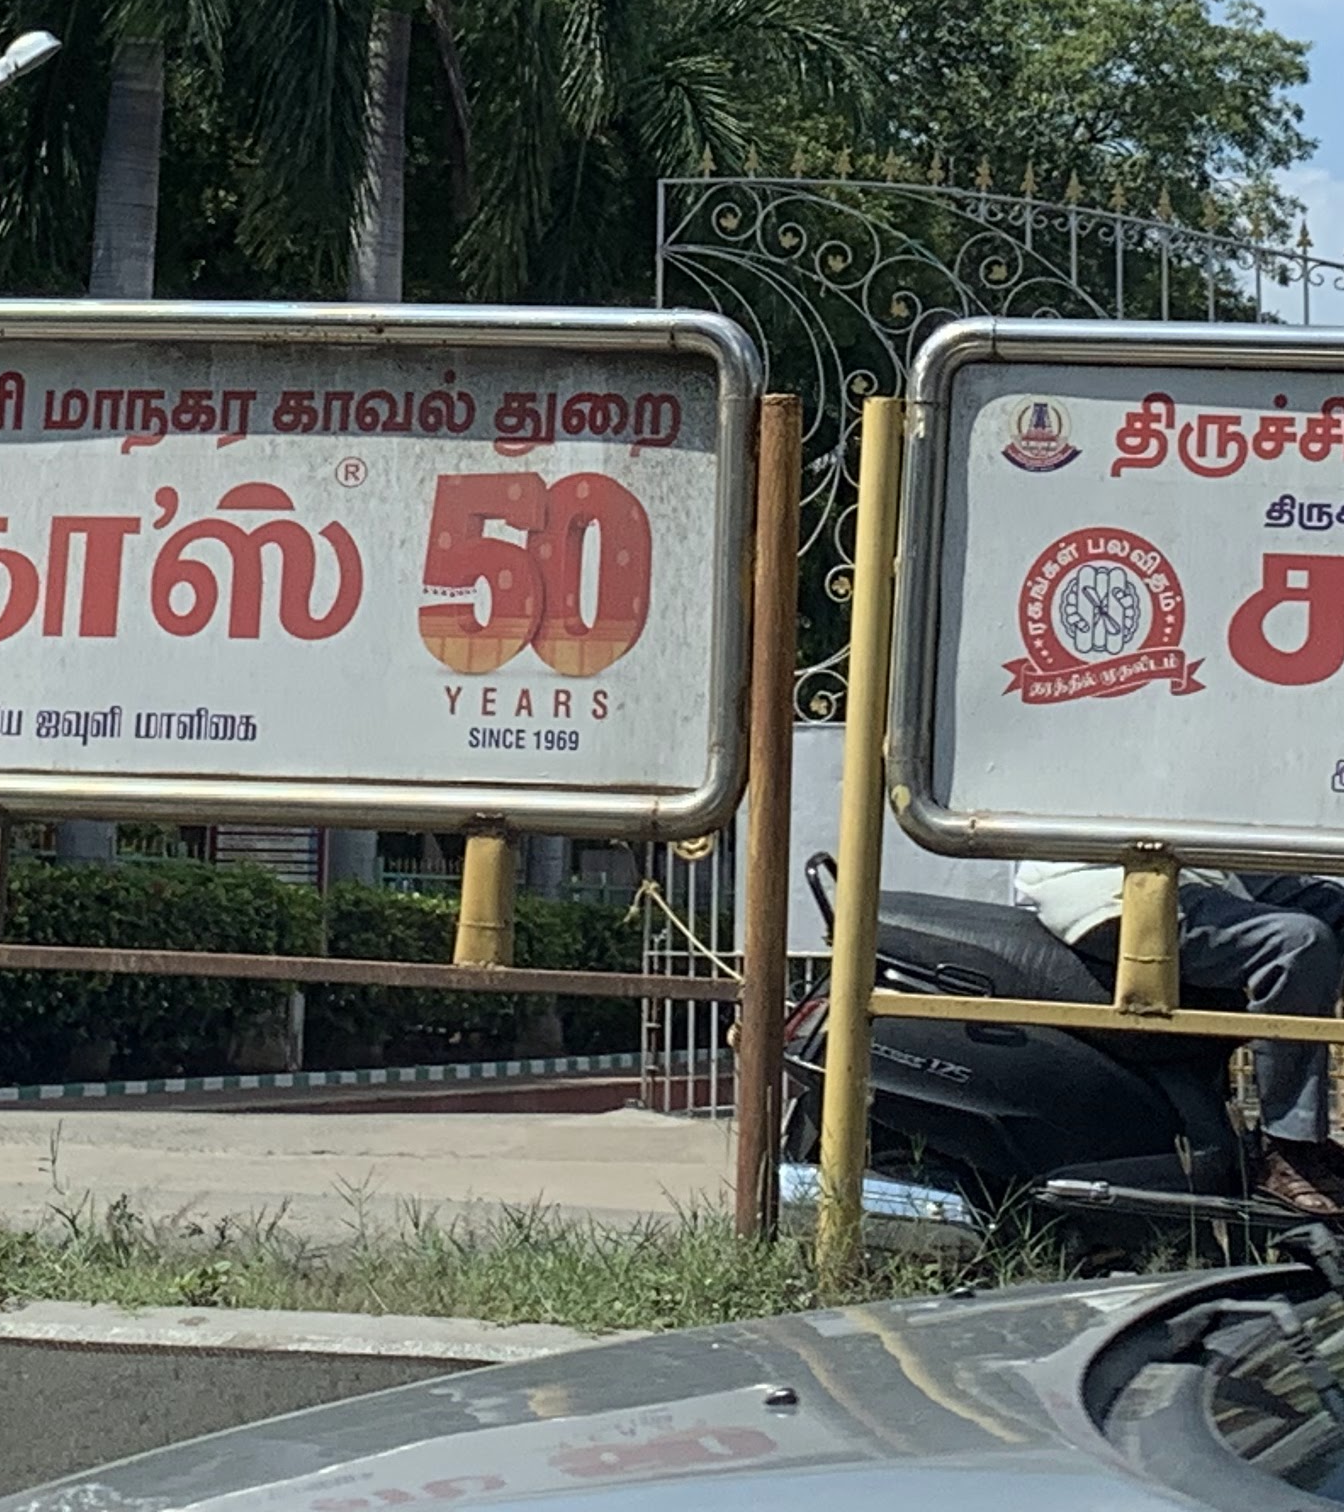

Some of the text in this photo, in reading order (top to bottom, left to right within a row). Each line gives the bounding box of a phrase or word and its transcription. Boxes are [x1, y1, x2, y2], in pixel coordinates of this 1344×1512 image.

[42, 387, 256, 454] மாநகர
[272, 370, 477, 436] காவல்
[493, 388, 682, 456] துறை
[418, 471, 653, 678] 50
[1086, 538, 1182, 612] பலவிதம்
[445, 685, 609, 721] YEARS
[36, 705, 123, 746] ஜவுளி
[134, 707, 257, 742] மாளிகை
[468, 726, 580, 752] SINCE 1969
[927, 1057, 974, 1084] 125
